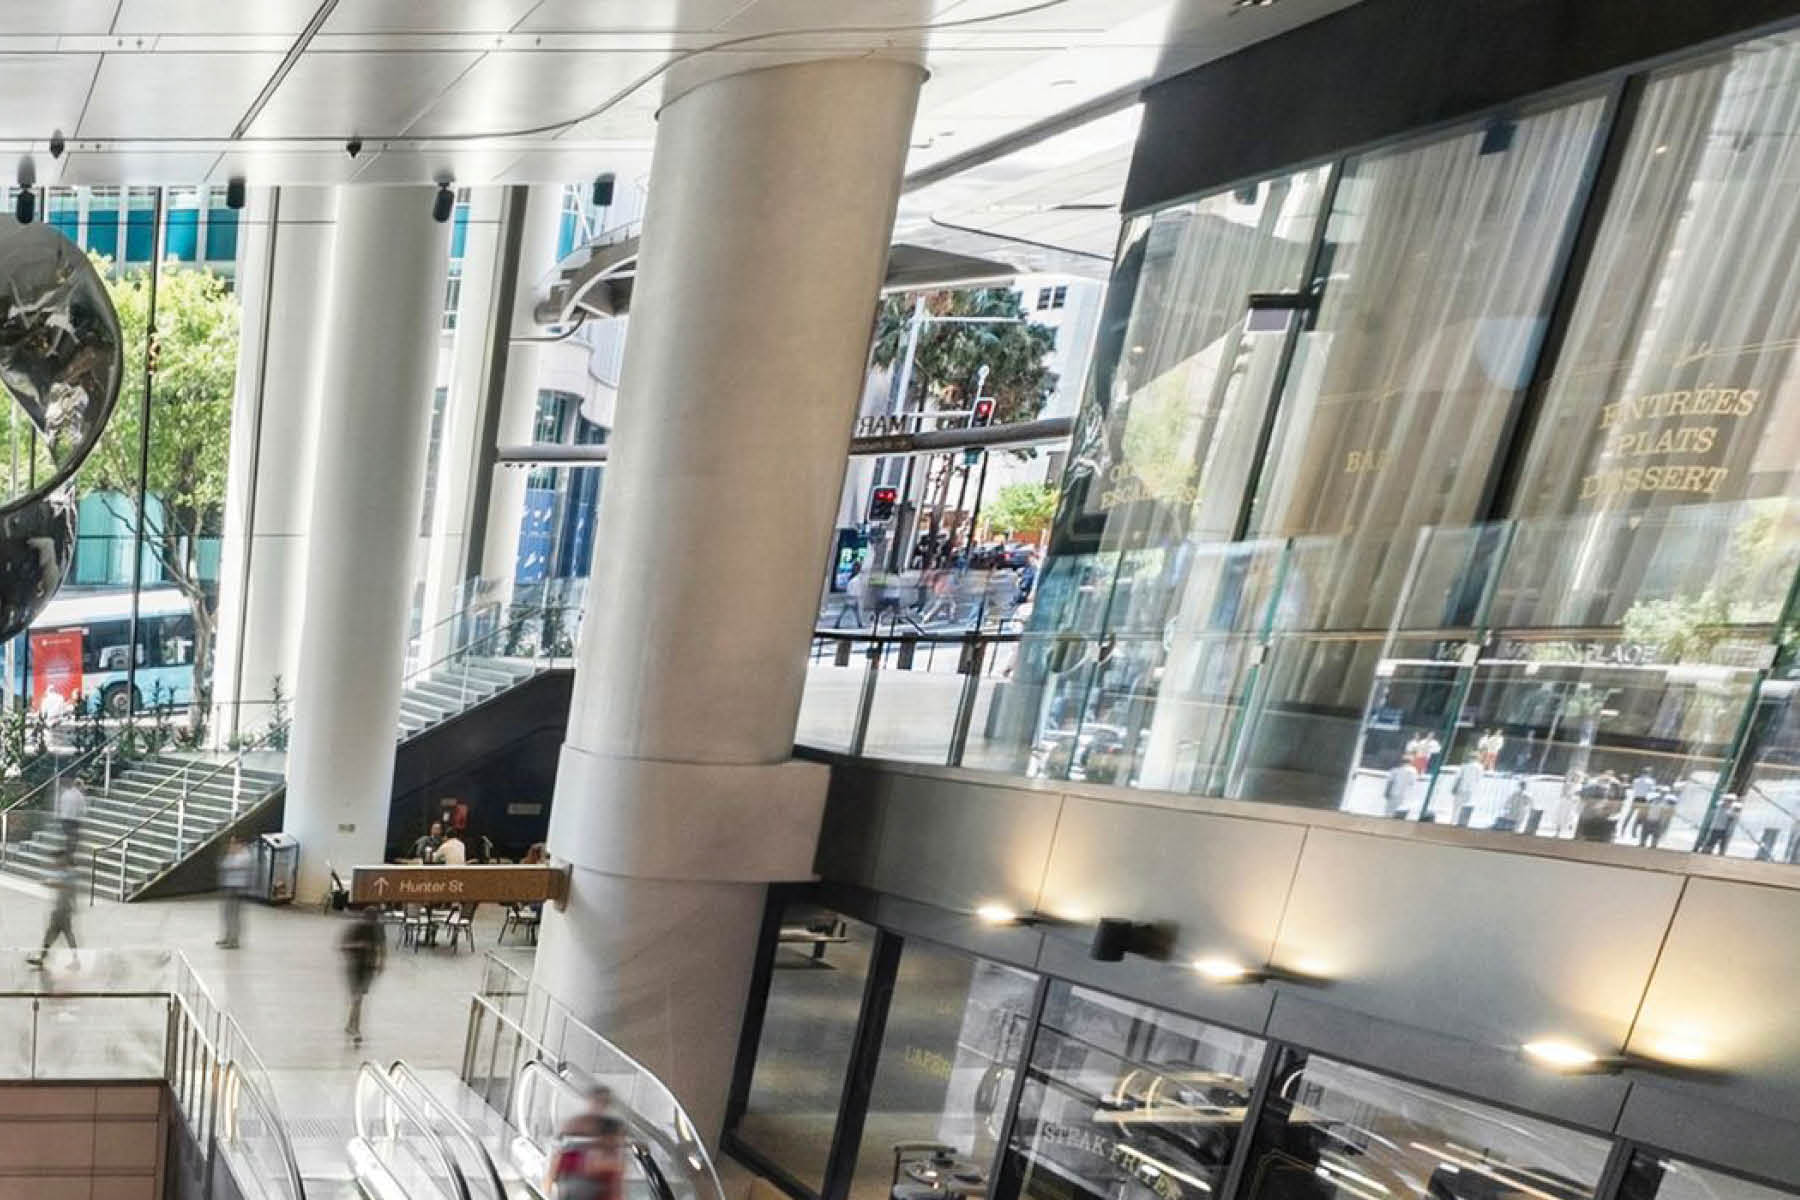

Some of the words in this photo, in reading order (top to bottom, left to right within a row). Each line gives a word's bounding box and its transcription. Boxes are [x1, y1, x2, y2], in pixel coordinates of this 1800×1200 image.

[1600, 381, 1759, 429] ENTRÉES
[1616, 426, 1719, 458] PLATS
[400, 880, 447, 893] Hunter
[448, 880, 464, 893] St
